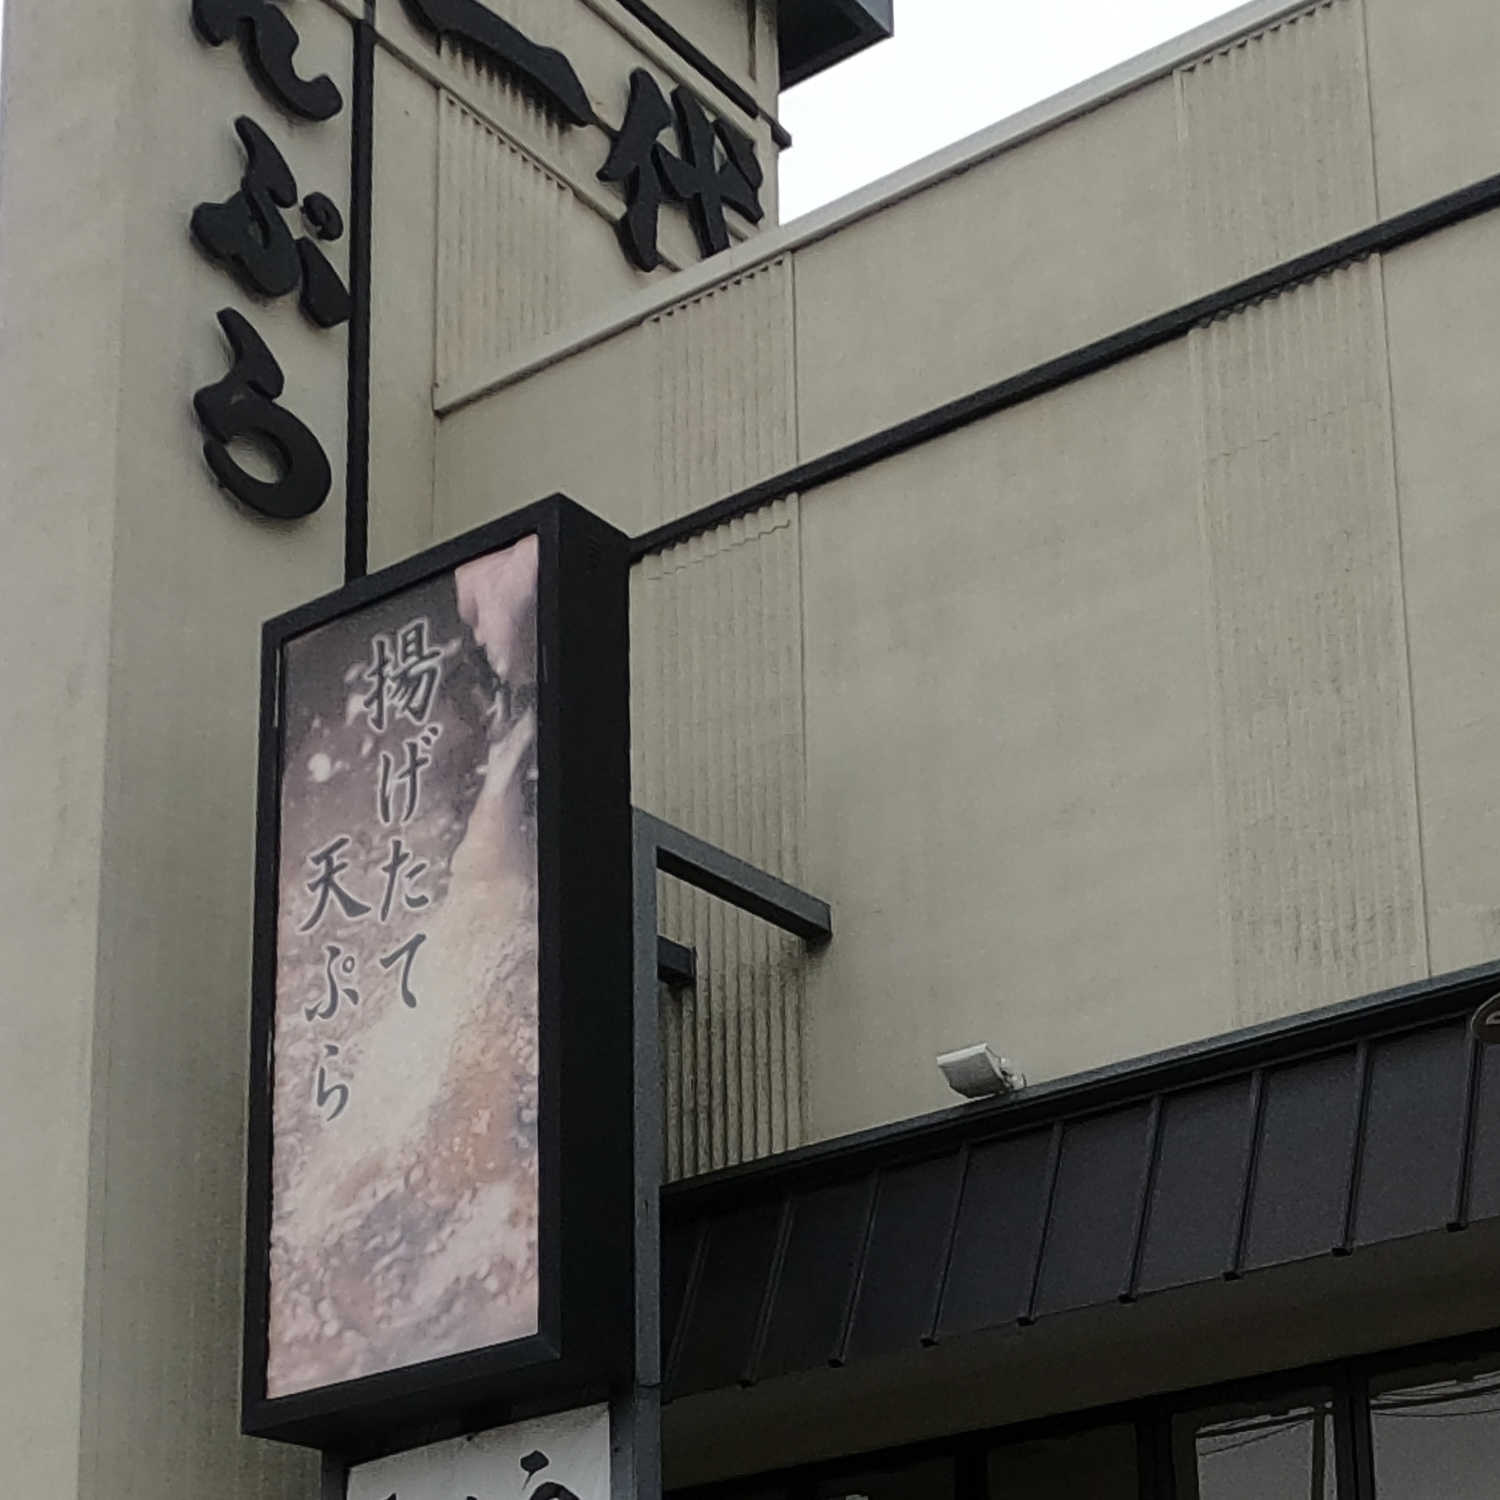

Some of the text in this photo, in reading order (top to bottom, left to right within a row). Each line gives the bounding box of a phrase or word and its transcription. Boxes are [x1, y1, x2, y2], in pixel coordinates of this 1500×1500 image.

[298, 835, 373, 1124] 天ぷら
[363, 614, 446, 1010] 揚げたて
